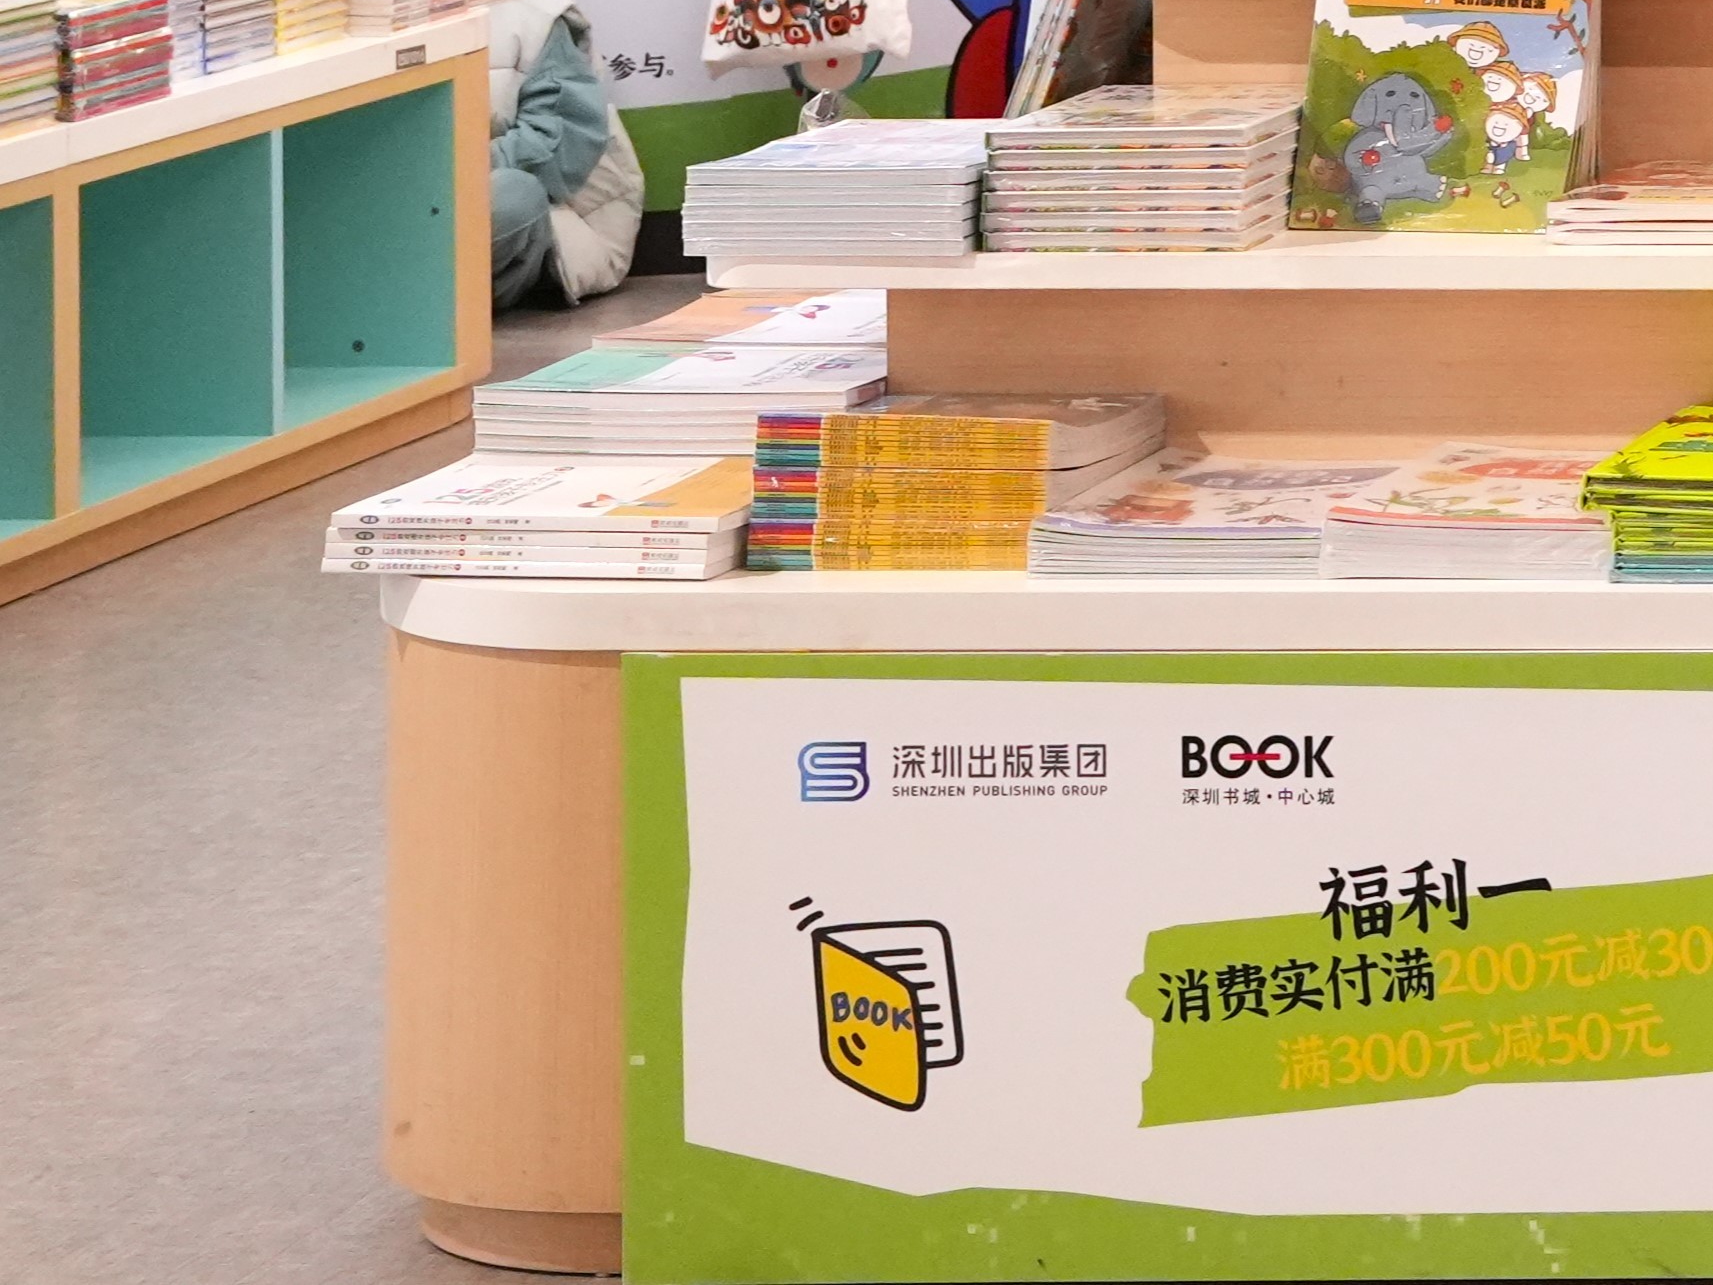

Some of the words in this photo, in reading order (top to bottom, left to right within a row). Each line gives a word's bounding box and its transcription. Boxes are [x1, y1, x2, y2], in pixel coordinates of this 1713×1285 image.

[892, 743, 1107, 781] 深圳出版集团
[1181, 734, 1335, 779] BOOK
[892, 784, 966, 797] SHENZHEN
[972, 784, 1056, 797] PUBLISHING
[1061, 784, 1108, 797] GROUP
[1182, 787, 1335, 807] 深圳书城·中心城
[1318, 860, 1553, 939] 福利一
[831, 991, 914, 1030] BOOK
[1277, 1004, 1673, 1091] 满300元减50元
